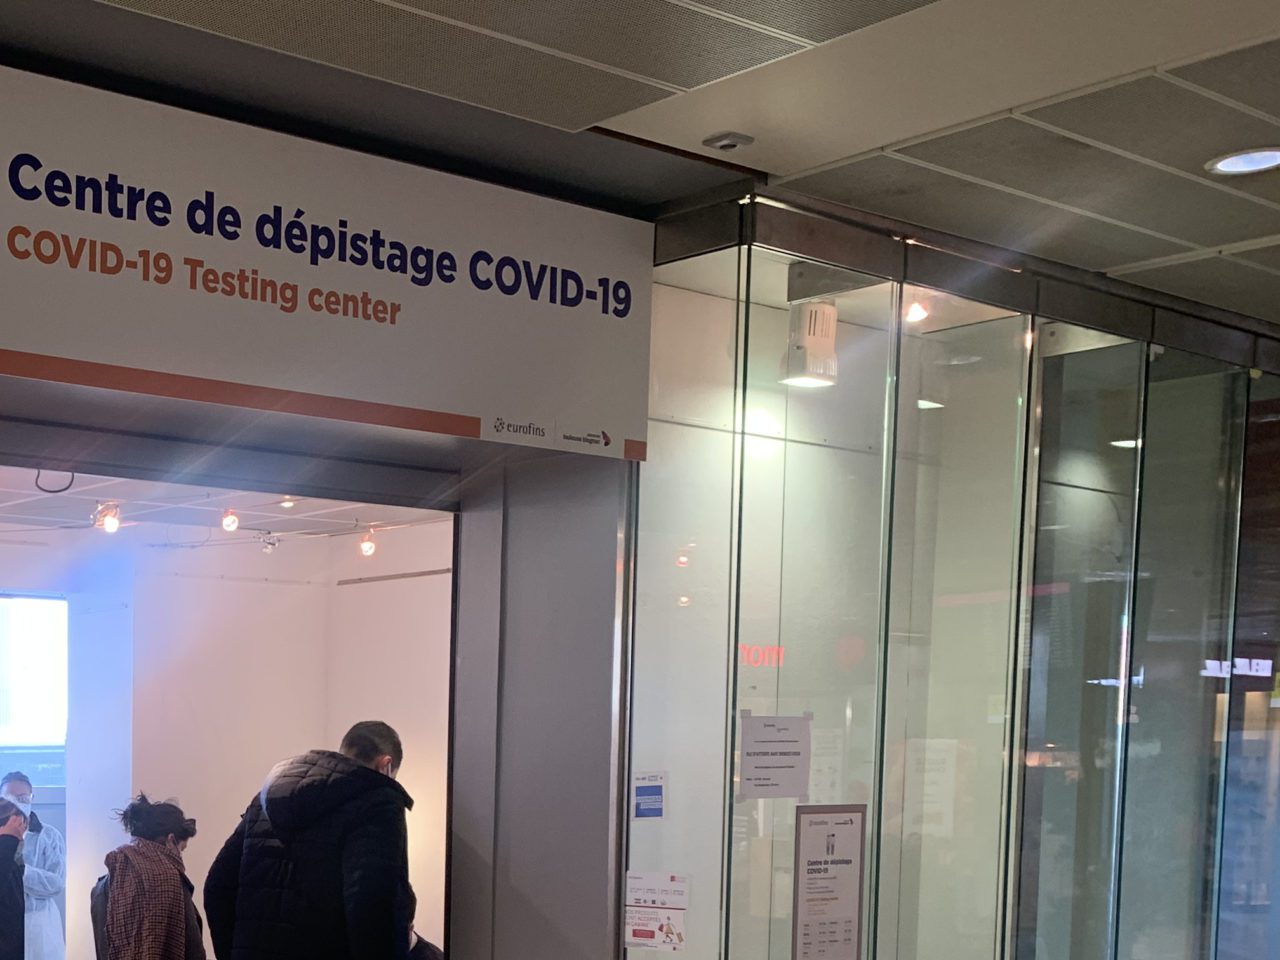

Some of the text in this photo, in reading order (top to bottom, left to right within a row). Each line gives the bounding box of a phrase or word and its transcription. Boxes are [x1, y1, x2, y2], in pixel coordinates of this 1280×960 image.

[7, 225, 401, 324] COVID-19 Testing center
[8, 153, 632, 318] Centre de dépistage COVID-19
[507, 422, 545, 437] eurofins
